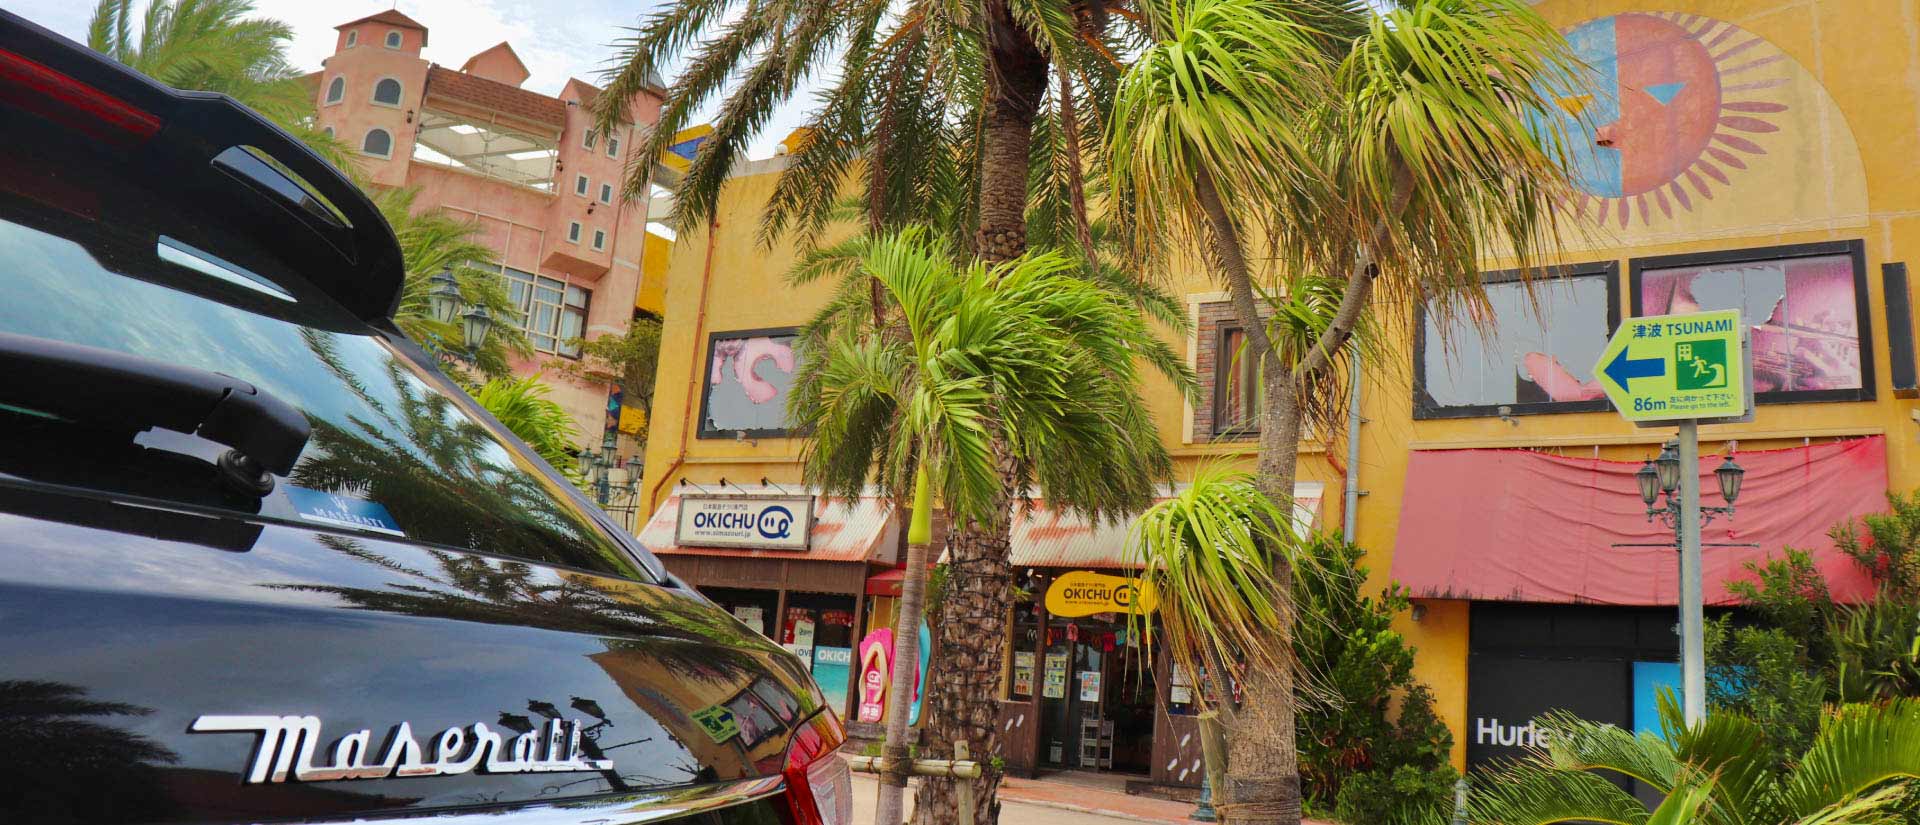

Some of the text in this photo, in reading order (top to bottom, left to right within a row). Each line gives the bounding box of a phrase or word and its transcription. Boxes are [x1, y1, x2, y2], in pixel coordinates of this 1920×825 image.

[1632, 319, 1733, 338] 津波 TSUNAMI
[1633, 397, 1667, 412] 86m
[694, 512, 755, 529] OKICHU
[1063, 588, 1111, 600] OKICHU
[1477, 716, 1572, 751] Hurle
[190, 714, 614, 784] Maserati
